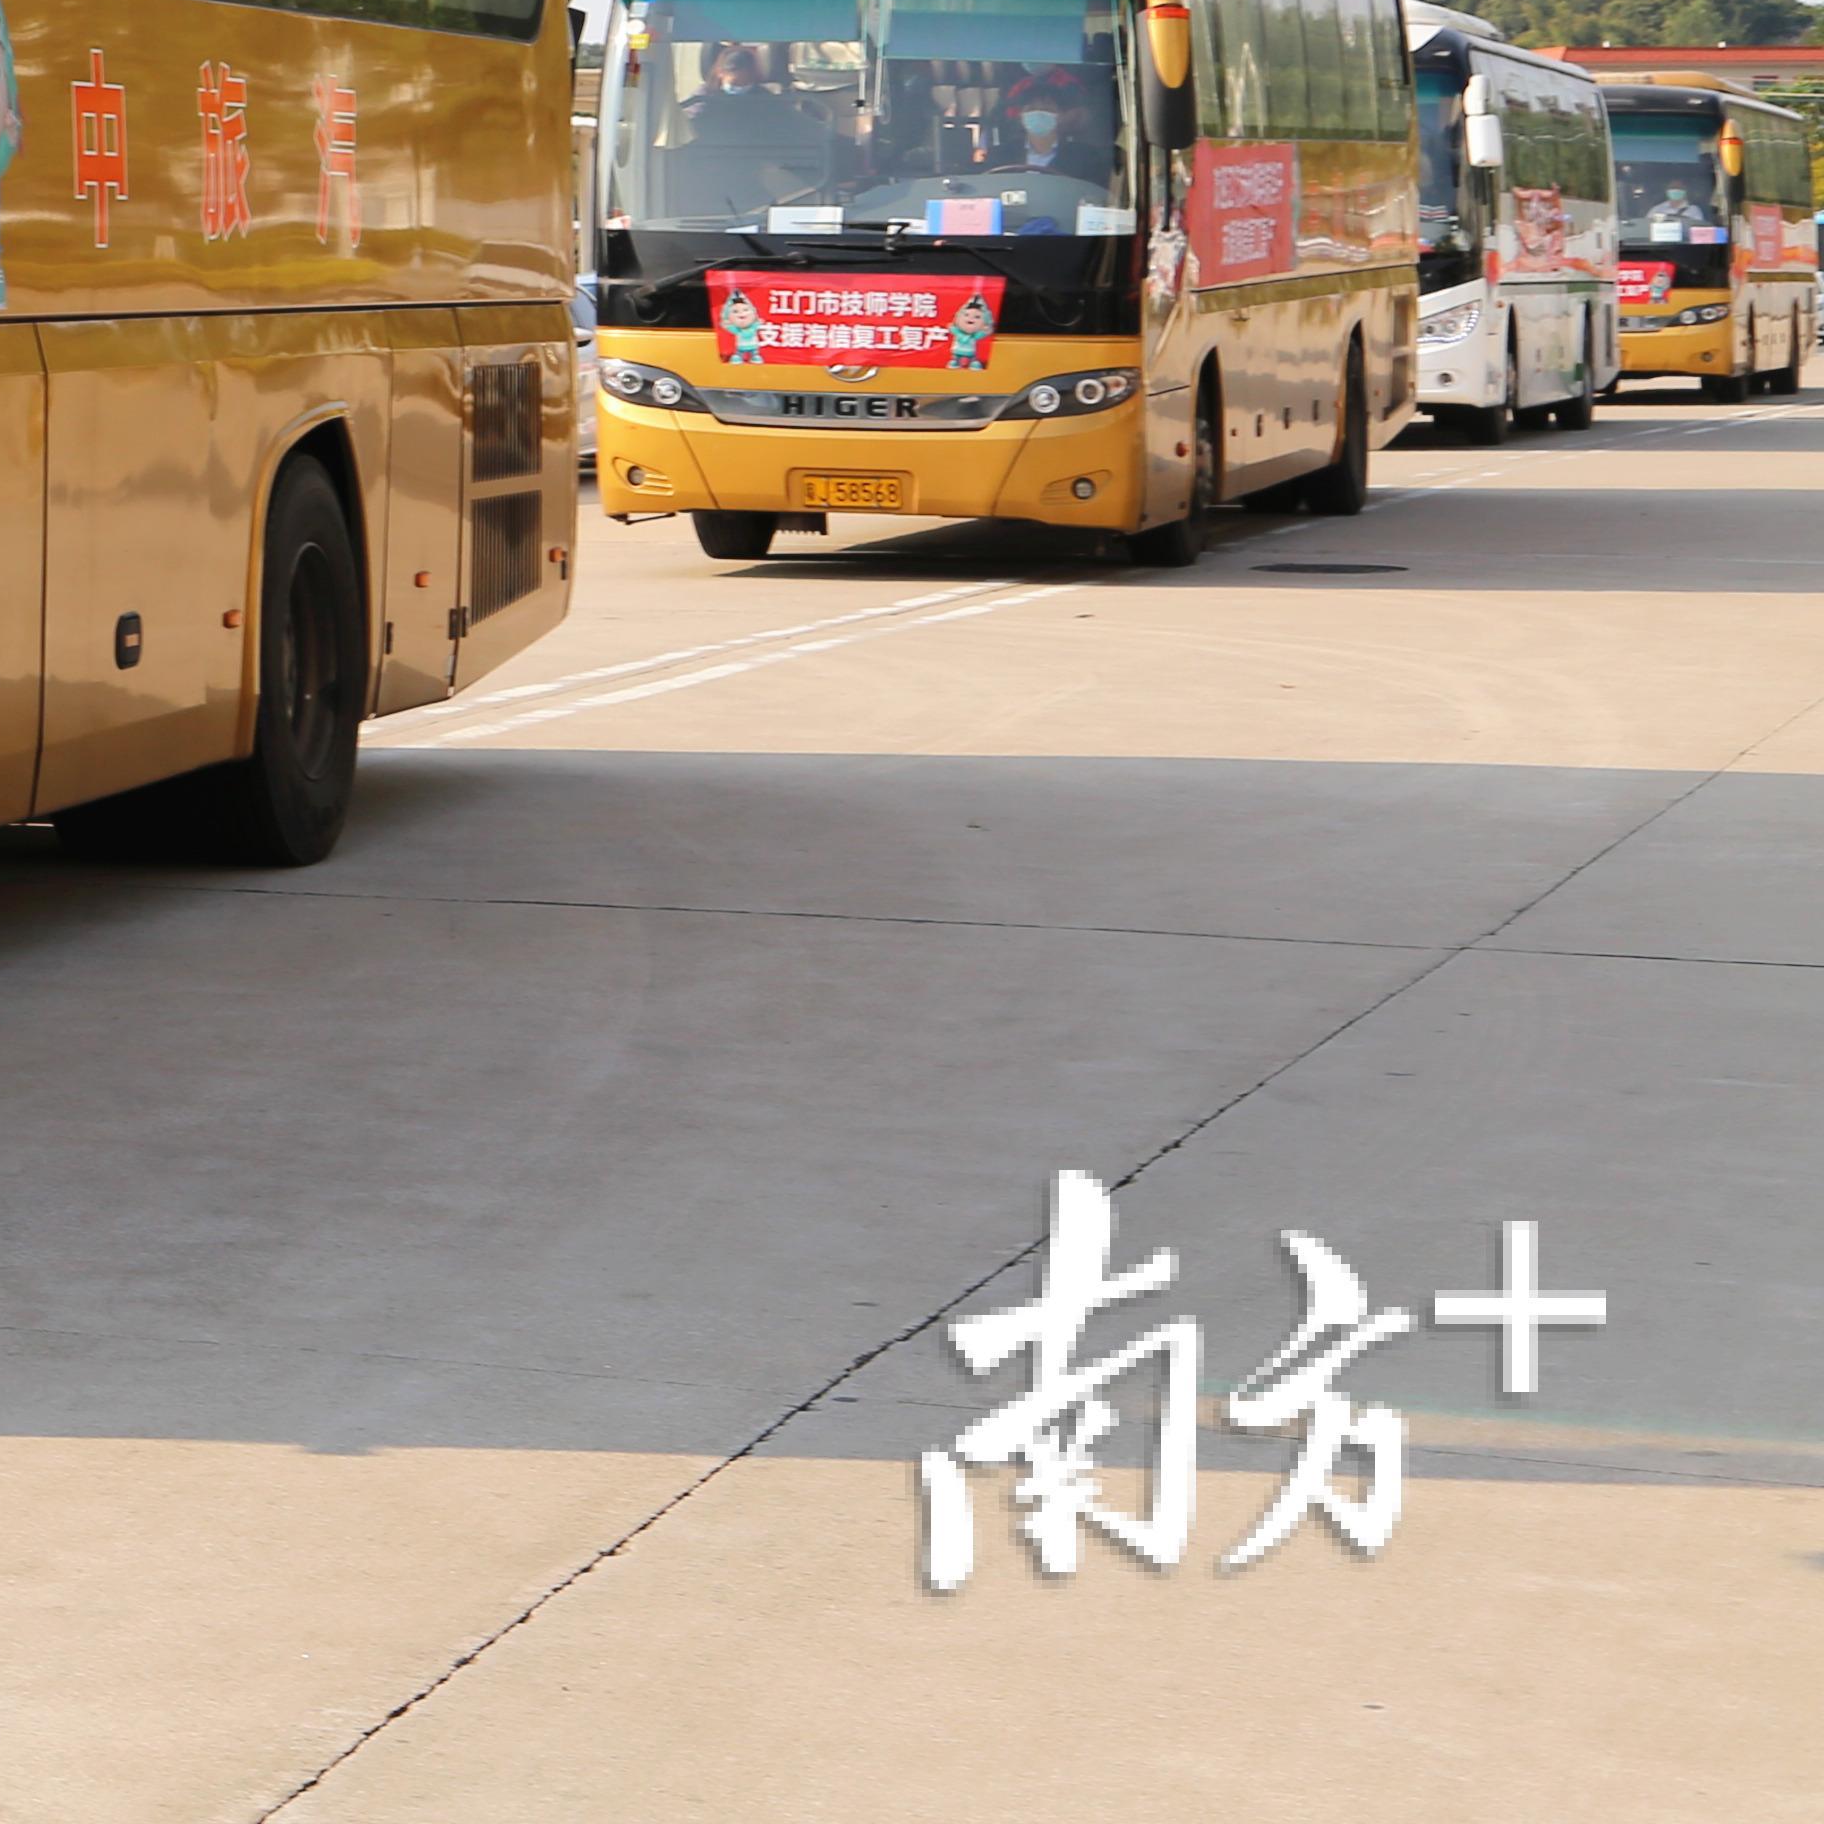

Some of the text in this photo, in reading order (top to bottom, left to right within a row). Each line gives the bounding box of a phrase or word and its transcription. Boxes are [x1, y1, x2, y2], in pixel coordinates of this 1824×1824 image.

[768, 288, 938, 320] 江门市技师学院
[757, 322, 950, 352] 支援海信复工复产
[782, 395, 920, 419] HIGER
